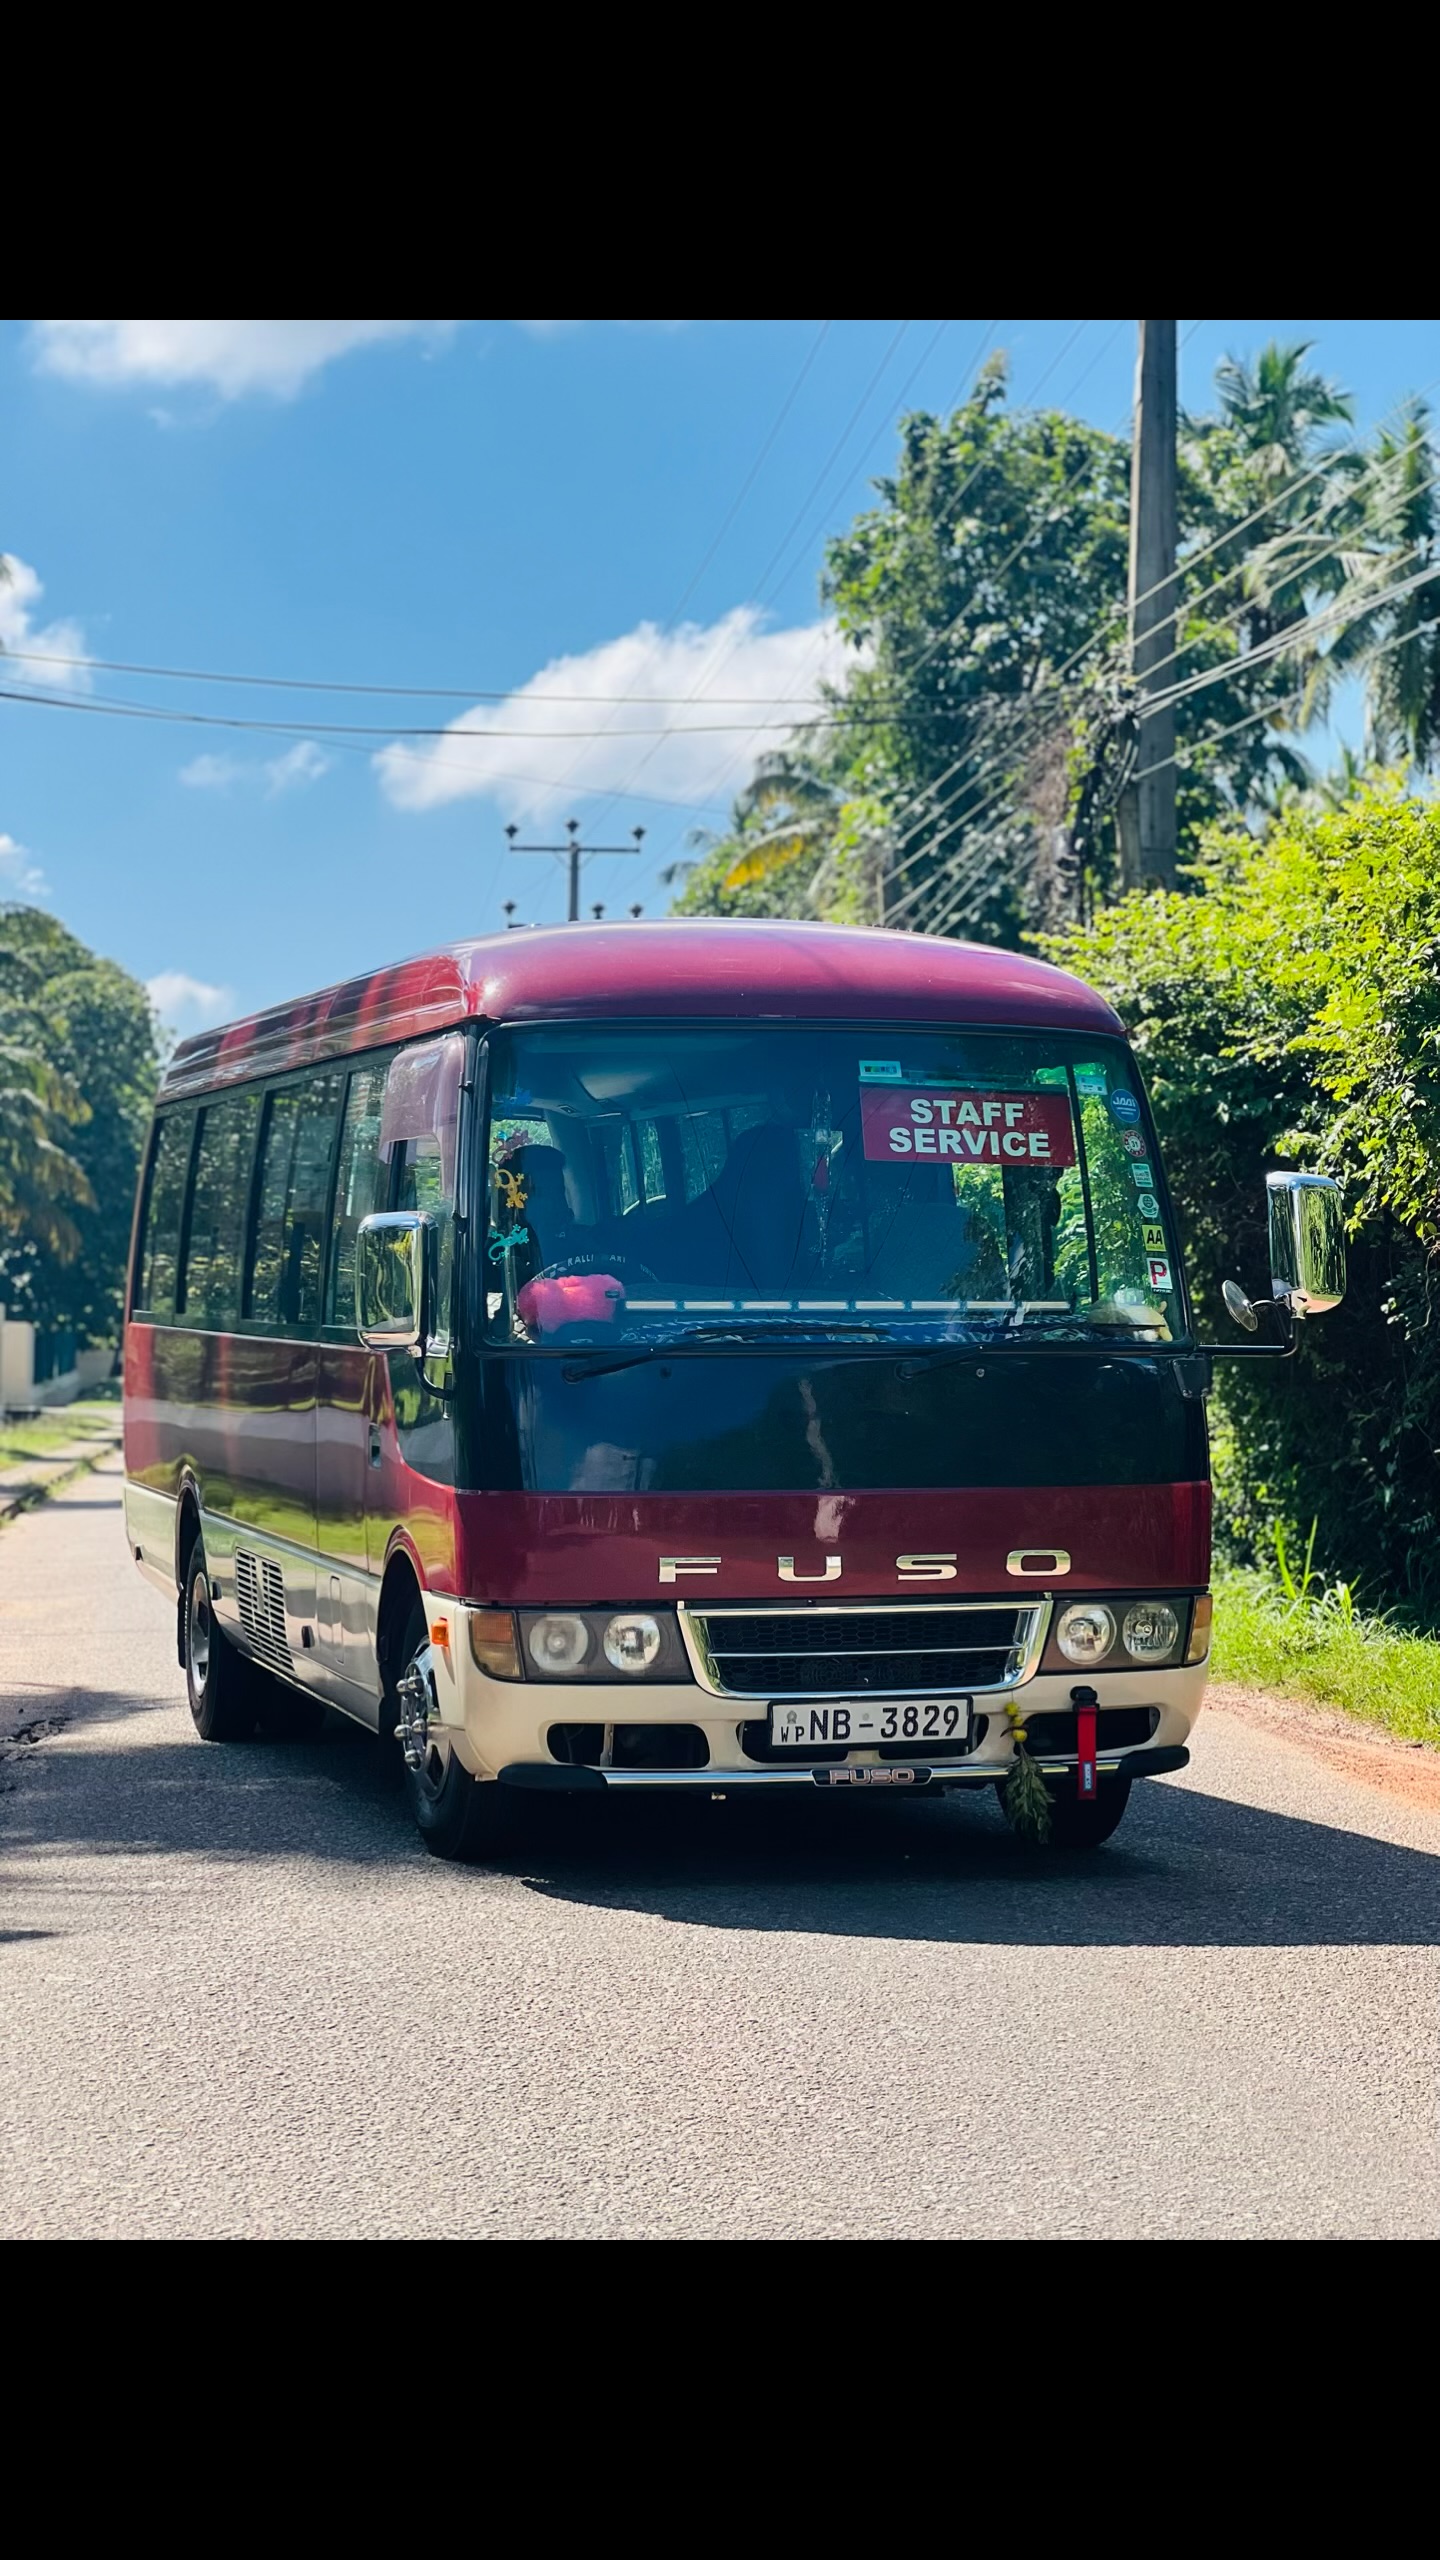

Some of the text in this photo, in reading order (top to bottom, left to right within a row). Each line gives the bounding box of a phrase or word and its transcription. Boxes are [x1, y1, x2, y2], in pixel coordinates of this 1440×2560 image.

[910, 1098, 1025, 1128] STAFF
[889, 1127, 1052, 1159] SERVICE
[1146, 1229, 1163, 1245] AA
[1149, 1260, 1168, 1285] P
[659, 1549, 1072, 1583] FUSO
[829, 1767, 916, 1785] FUSO
